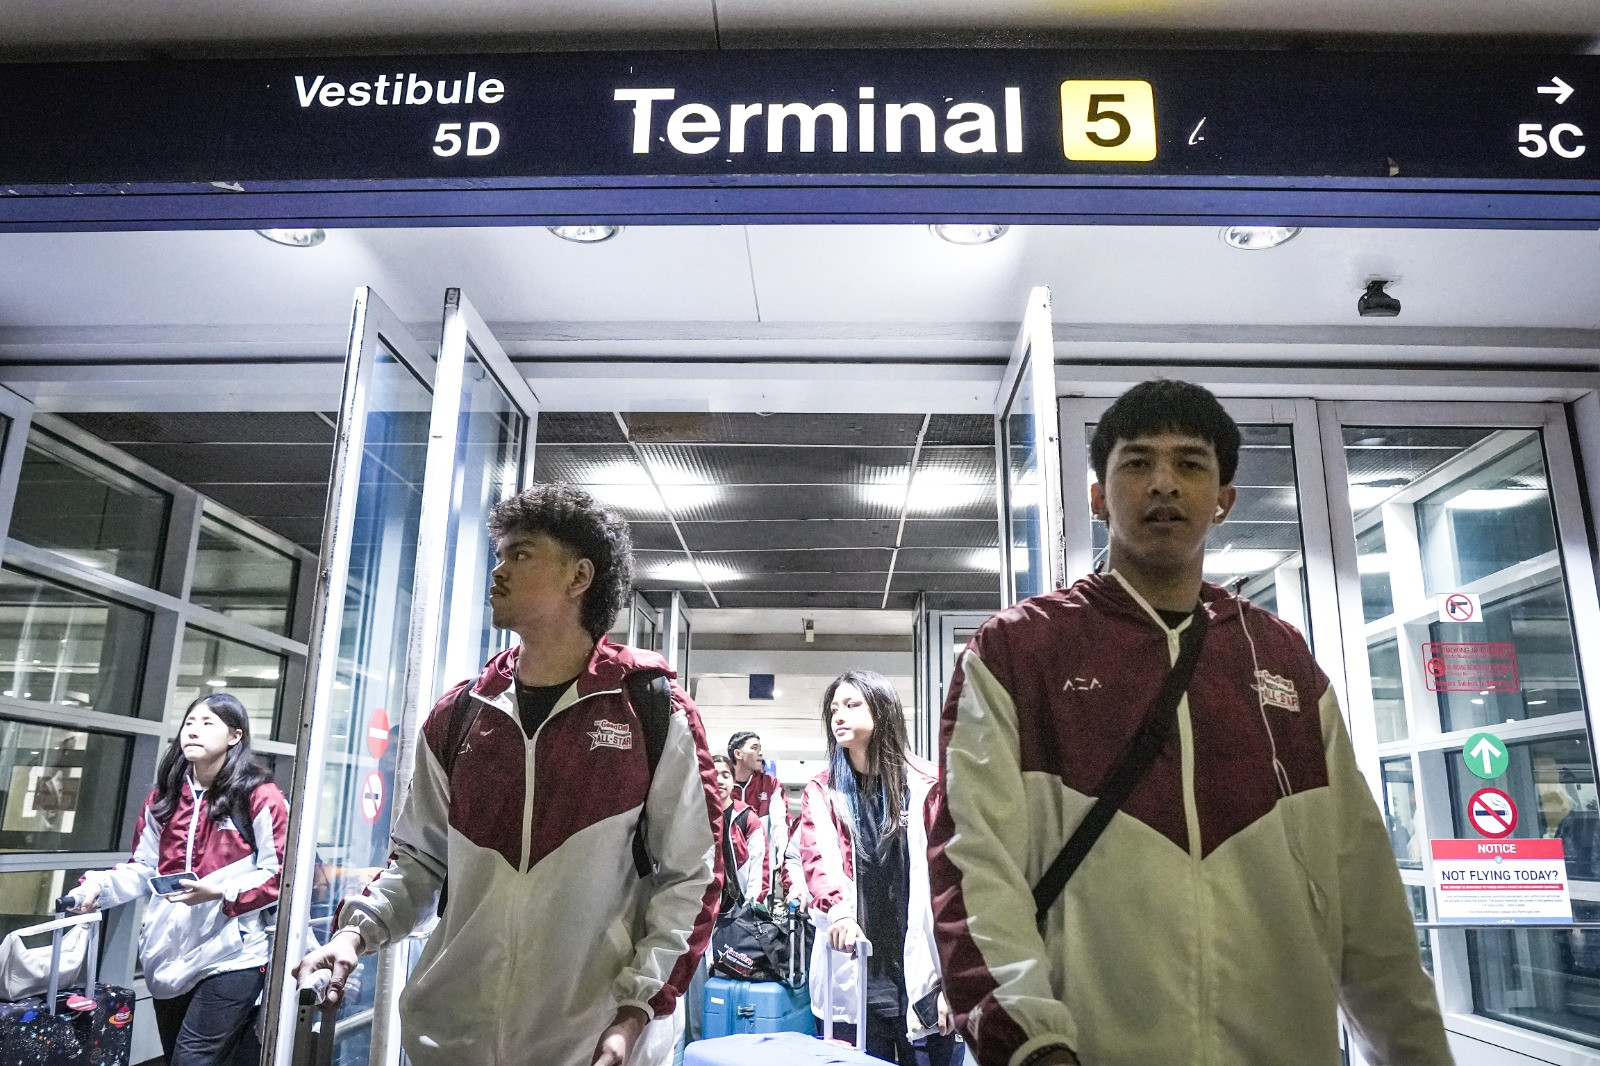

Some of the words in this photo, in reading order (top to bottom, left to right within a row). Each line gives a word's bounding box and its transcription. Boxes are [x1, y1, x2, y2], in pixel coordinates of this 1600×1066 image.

[294, 71, 505, 107] Vestibule
[613, 86, 1023, 154] Terminal
[1084, 94, 1131, 147] 5
[432, 121, 500, 157] 5D
[1518, 123, 1586, 159] 5C
[1477, 843, 1517, 854] NOTICE
[1442, 870, 1466, 881] NOT
[1470, 870, 1511, 881] FLYING
[1514, 870, 1559, 881] TODAY?
